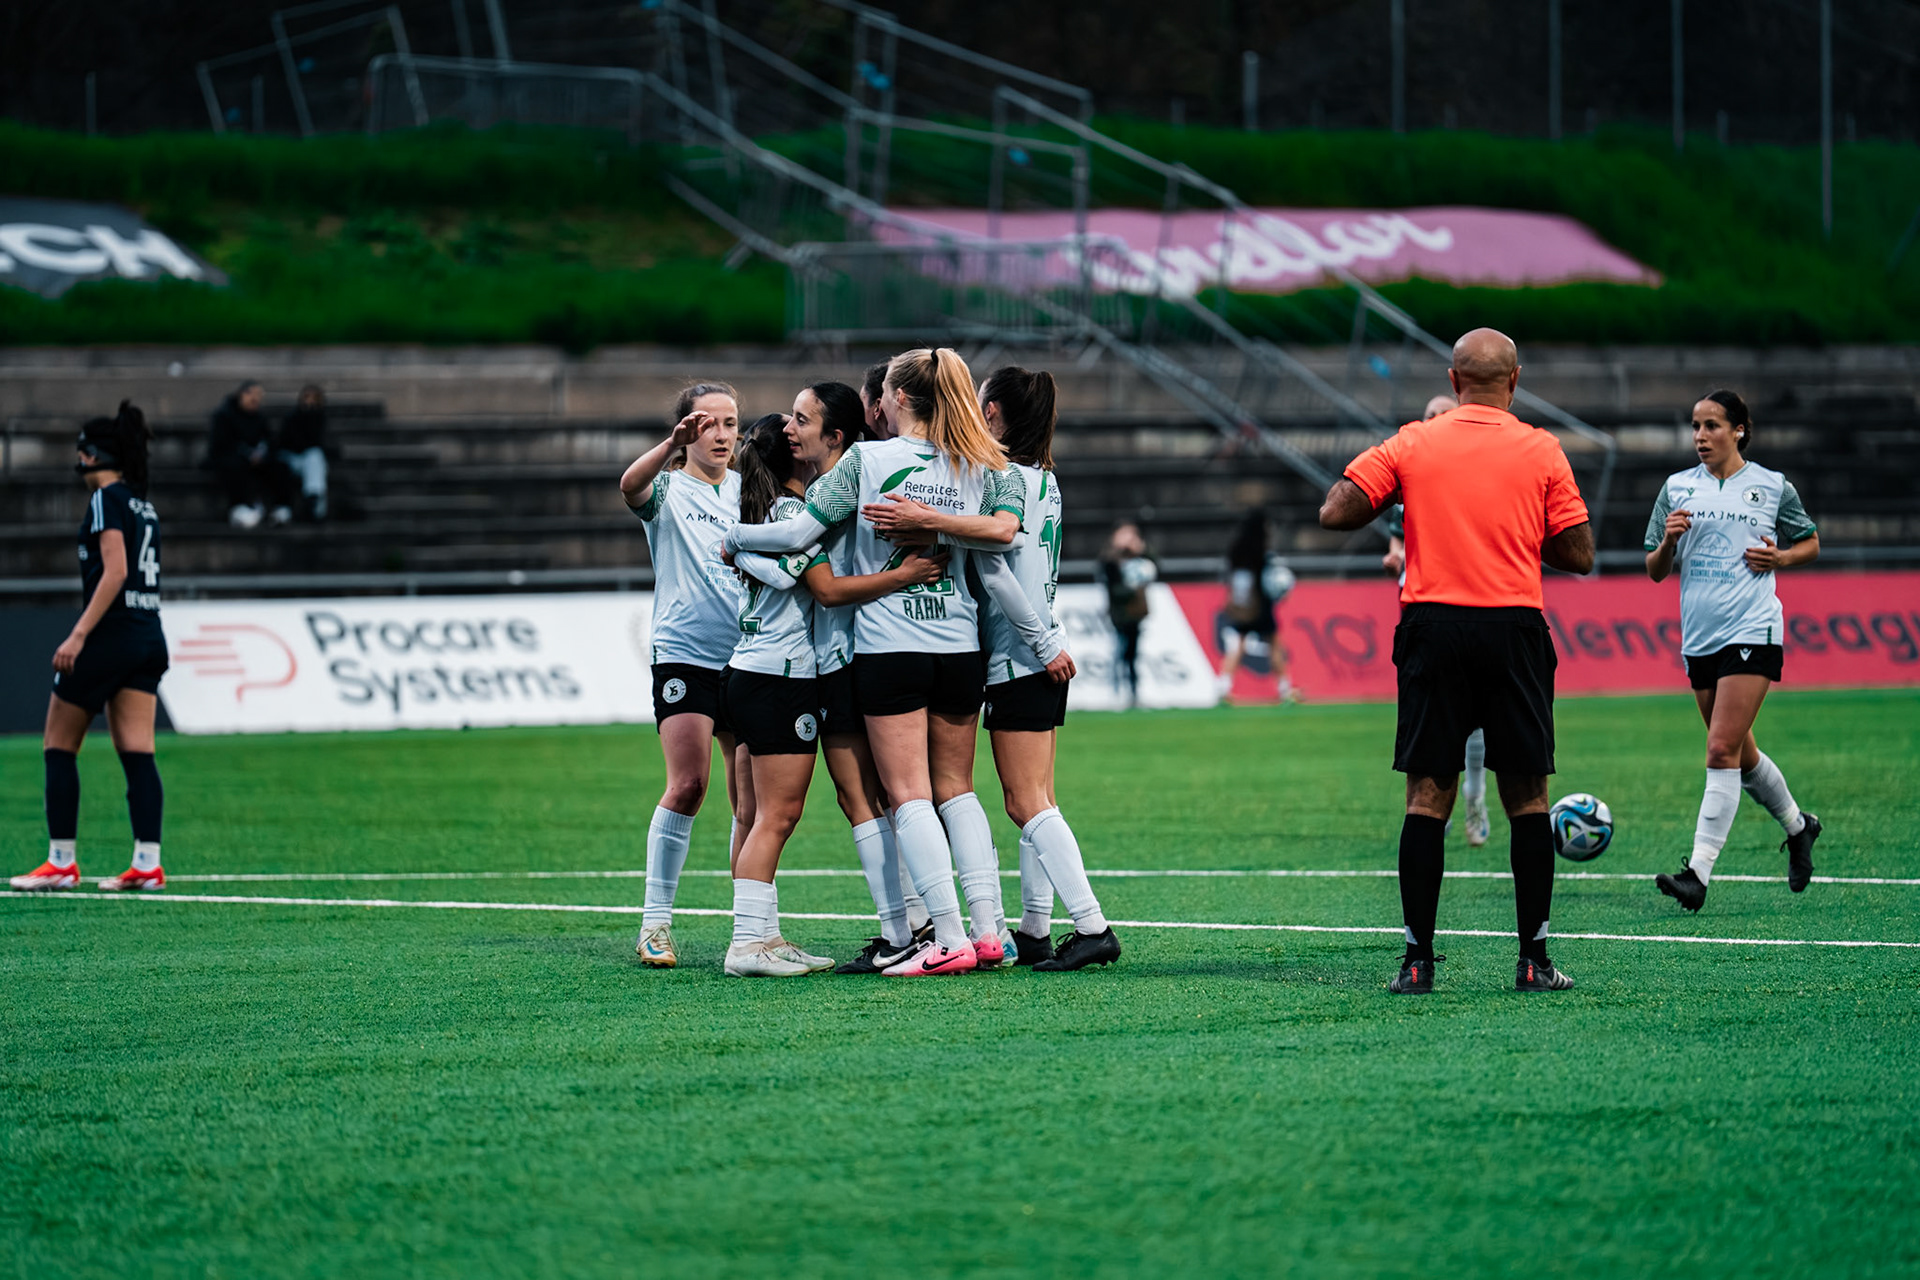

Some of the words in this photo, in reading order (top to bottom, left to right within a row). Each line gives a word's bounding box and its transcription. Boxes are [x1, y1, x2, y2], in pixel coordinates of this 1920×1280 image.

[0, 222, 203, 280] CH
[904, 481, 958, 497] Retraites
[138, 524, 160, 587] 4
[304, 610, 541, 654] Procare
[902, 596, 946, 620] RAHM
[1784, 611, 1920, 664] eag
[329, 657, 581, 713] Systems
